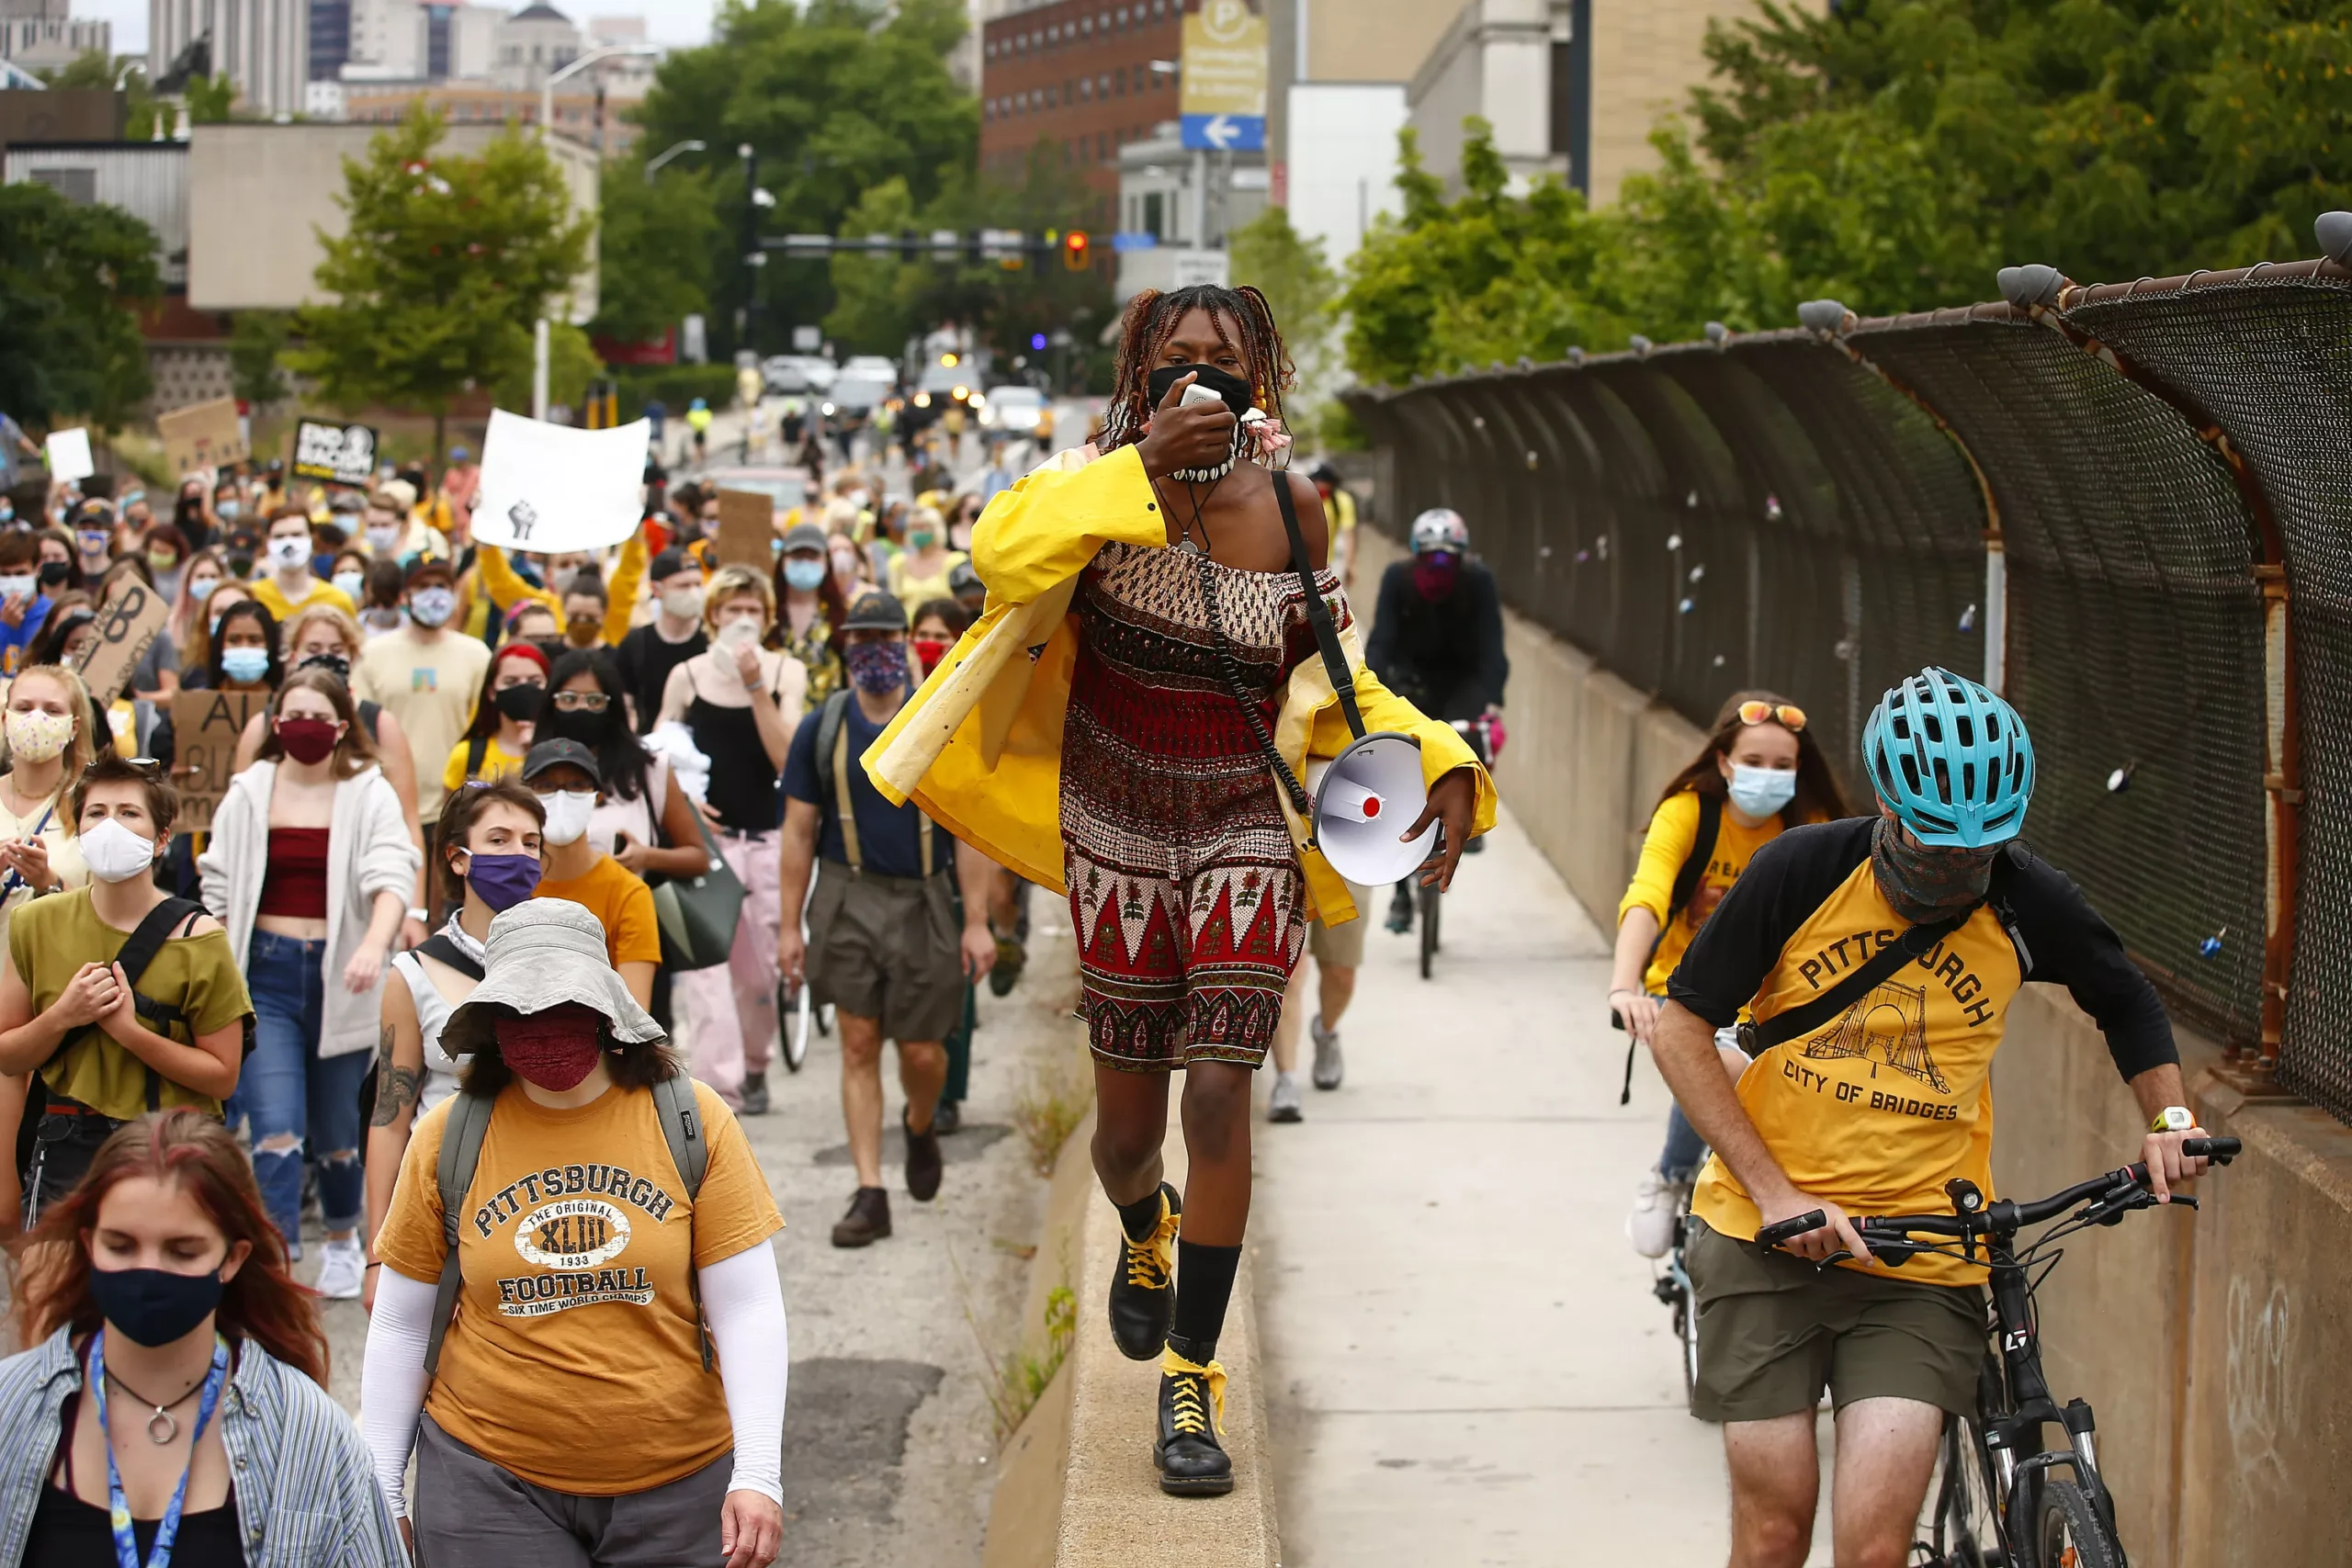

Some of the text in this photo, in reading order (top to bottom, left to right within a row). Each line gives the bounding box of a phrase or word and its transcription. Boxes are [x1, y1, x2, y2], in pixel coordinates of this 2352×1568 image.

[1798, 929, 1995, 1028] PITTSURGH
[1783, 1059, 1958, 1121] CITY OF BRIDGES
[474, 1164, 675, 1239] PITTSBURGH
[528, 1202, 613, 1226] THE ORIGINAL
[539, 1215, 606, 1254] XLIII
[560, 1255, 589, 1267] 1933
[497, 1268, 653, 1302] FOOTBALL
[508, 1292, 648, 1315] SIX TIME WORLD CHAMPS
